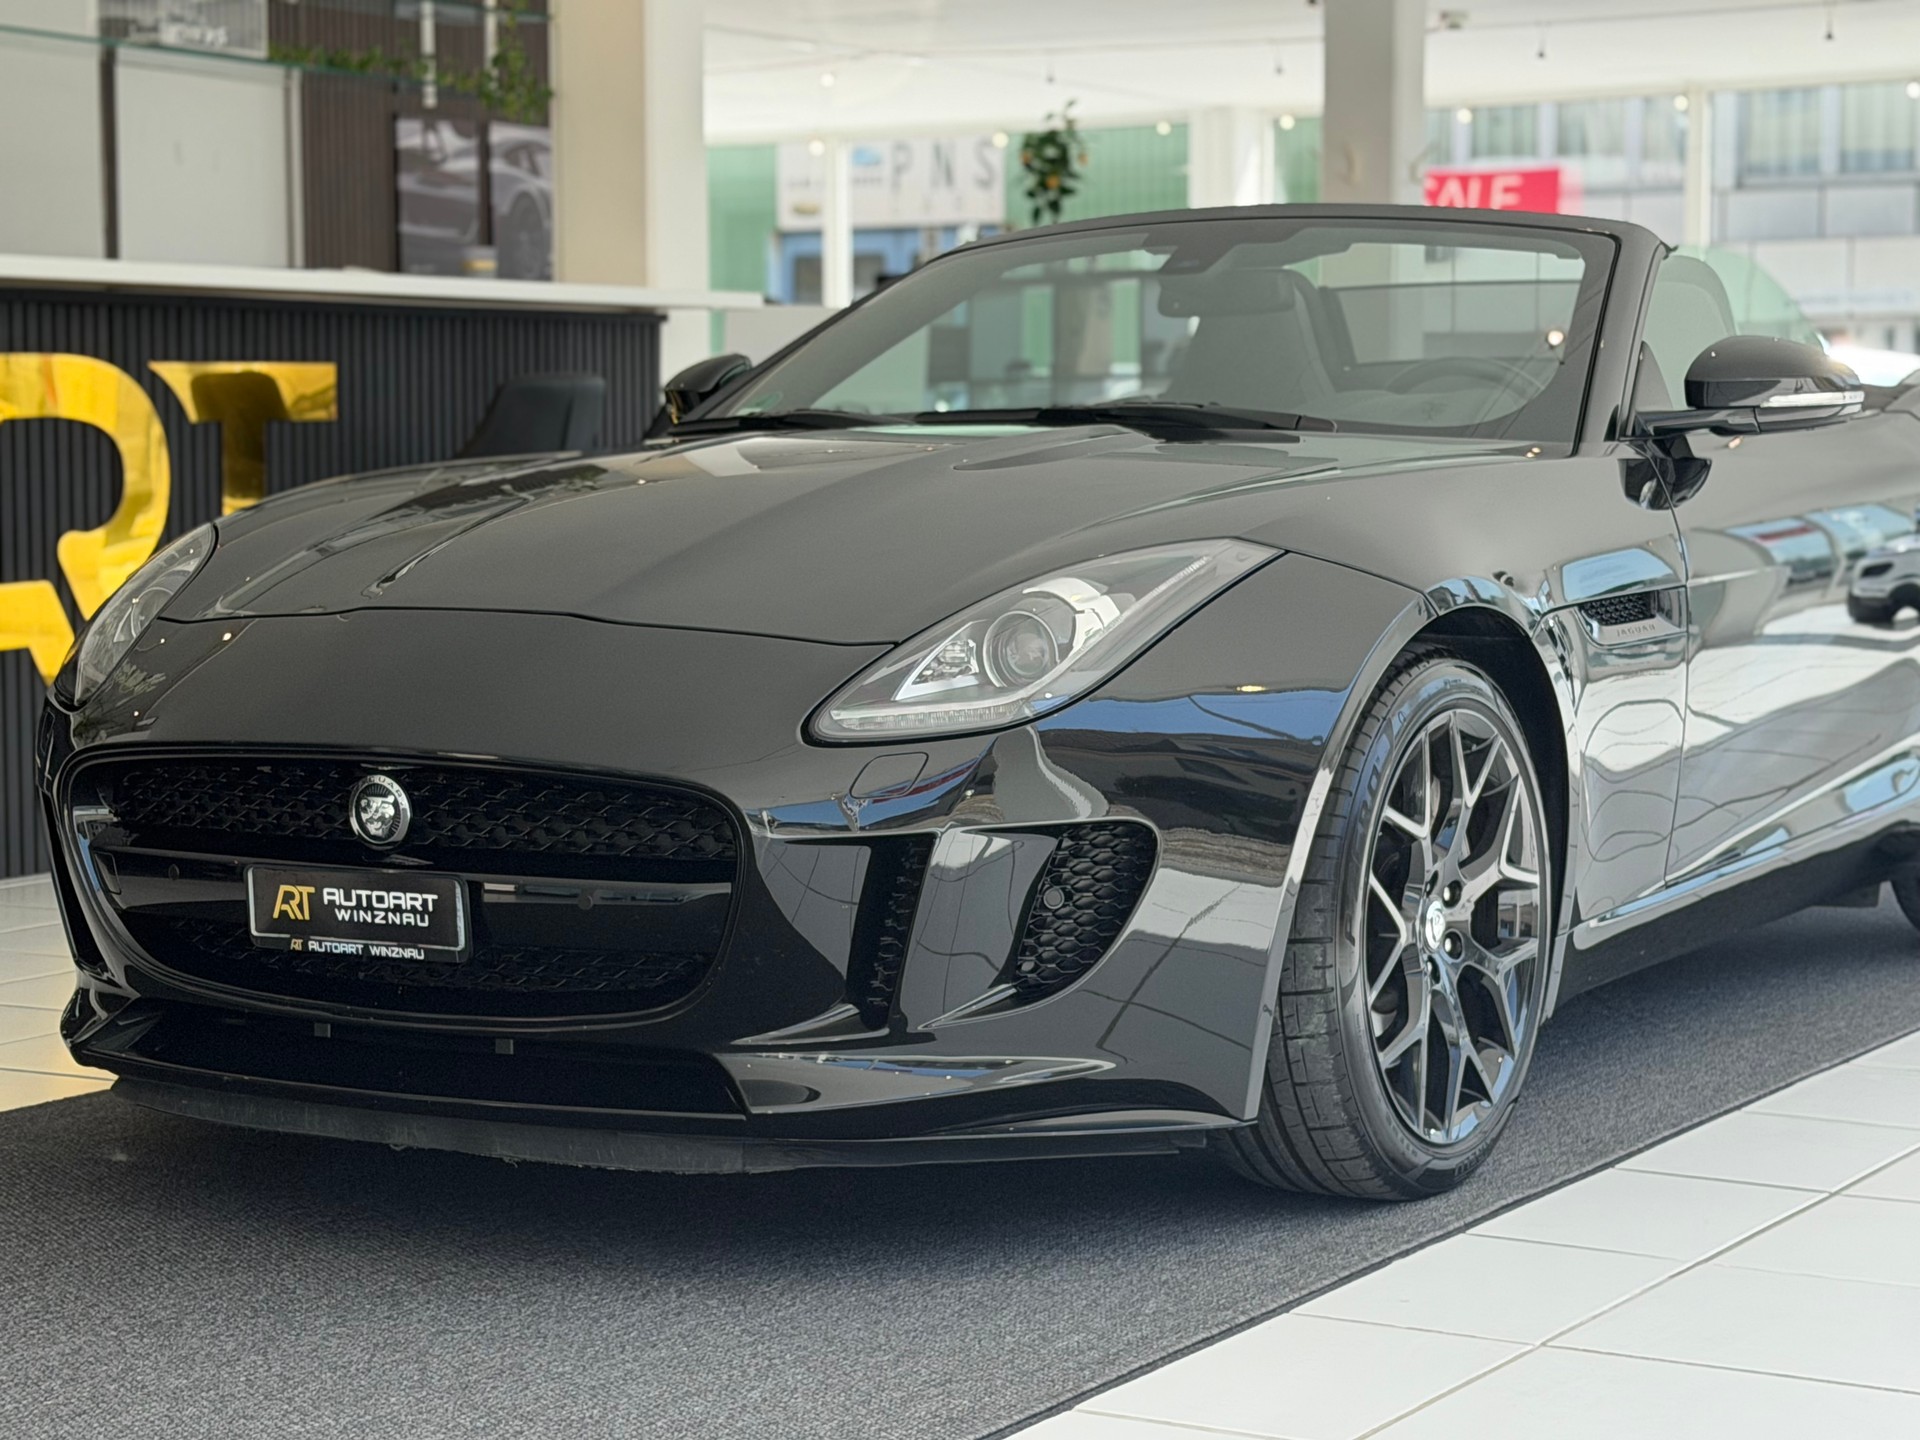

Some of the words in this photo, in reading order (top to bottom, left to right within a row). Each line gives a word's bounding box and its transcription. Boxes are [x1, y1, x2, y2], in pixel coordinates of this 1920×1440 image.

[322, 887, 439, 913] AUTOART
[334, 908, 430, 928] WINZNAU
[308, 940, 364, 955] AUTOART
[369, 946, 425, 960] WINZNAU
